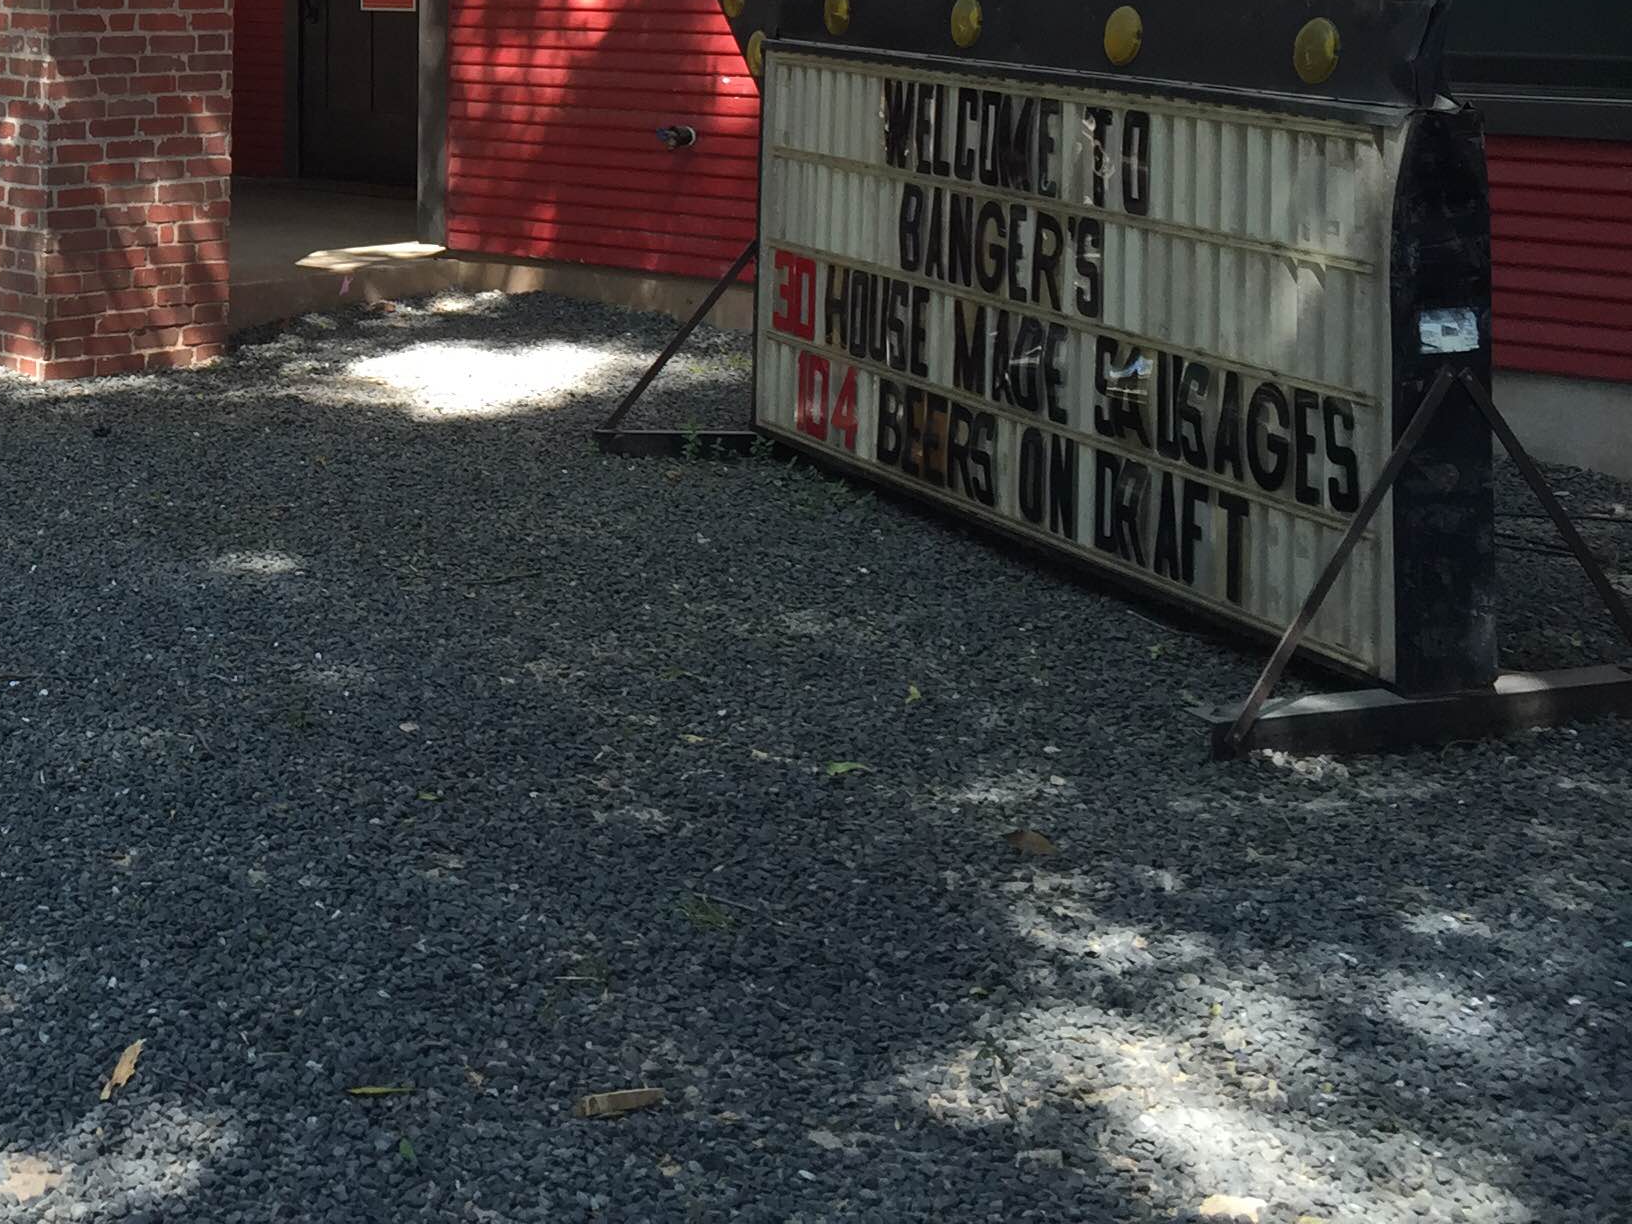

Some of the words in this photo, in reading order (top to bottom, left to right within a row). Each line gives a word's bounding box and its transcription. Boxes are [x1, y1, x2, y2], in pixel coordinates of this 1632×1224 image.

[884, 77, 1063, 198] WELCOME
[1083, 106, 1150, 216] TO
[899, 182, 1103, 318] BANGER'S
[772, 248, 817, 342] 30
[825, 264, 930, 378] HOUSE
[953, 297, 1068, 425] MADE
[1095, 335, 1361, 514] SAUSAGES
[796, 350, 859, 451] 104
[876, 378, 997, 508] BEERS
[1019, 427, 1075, 542] ON
[1095, 448, 1250, 605] DRAFT
